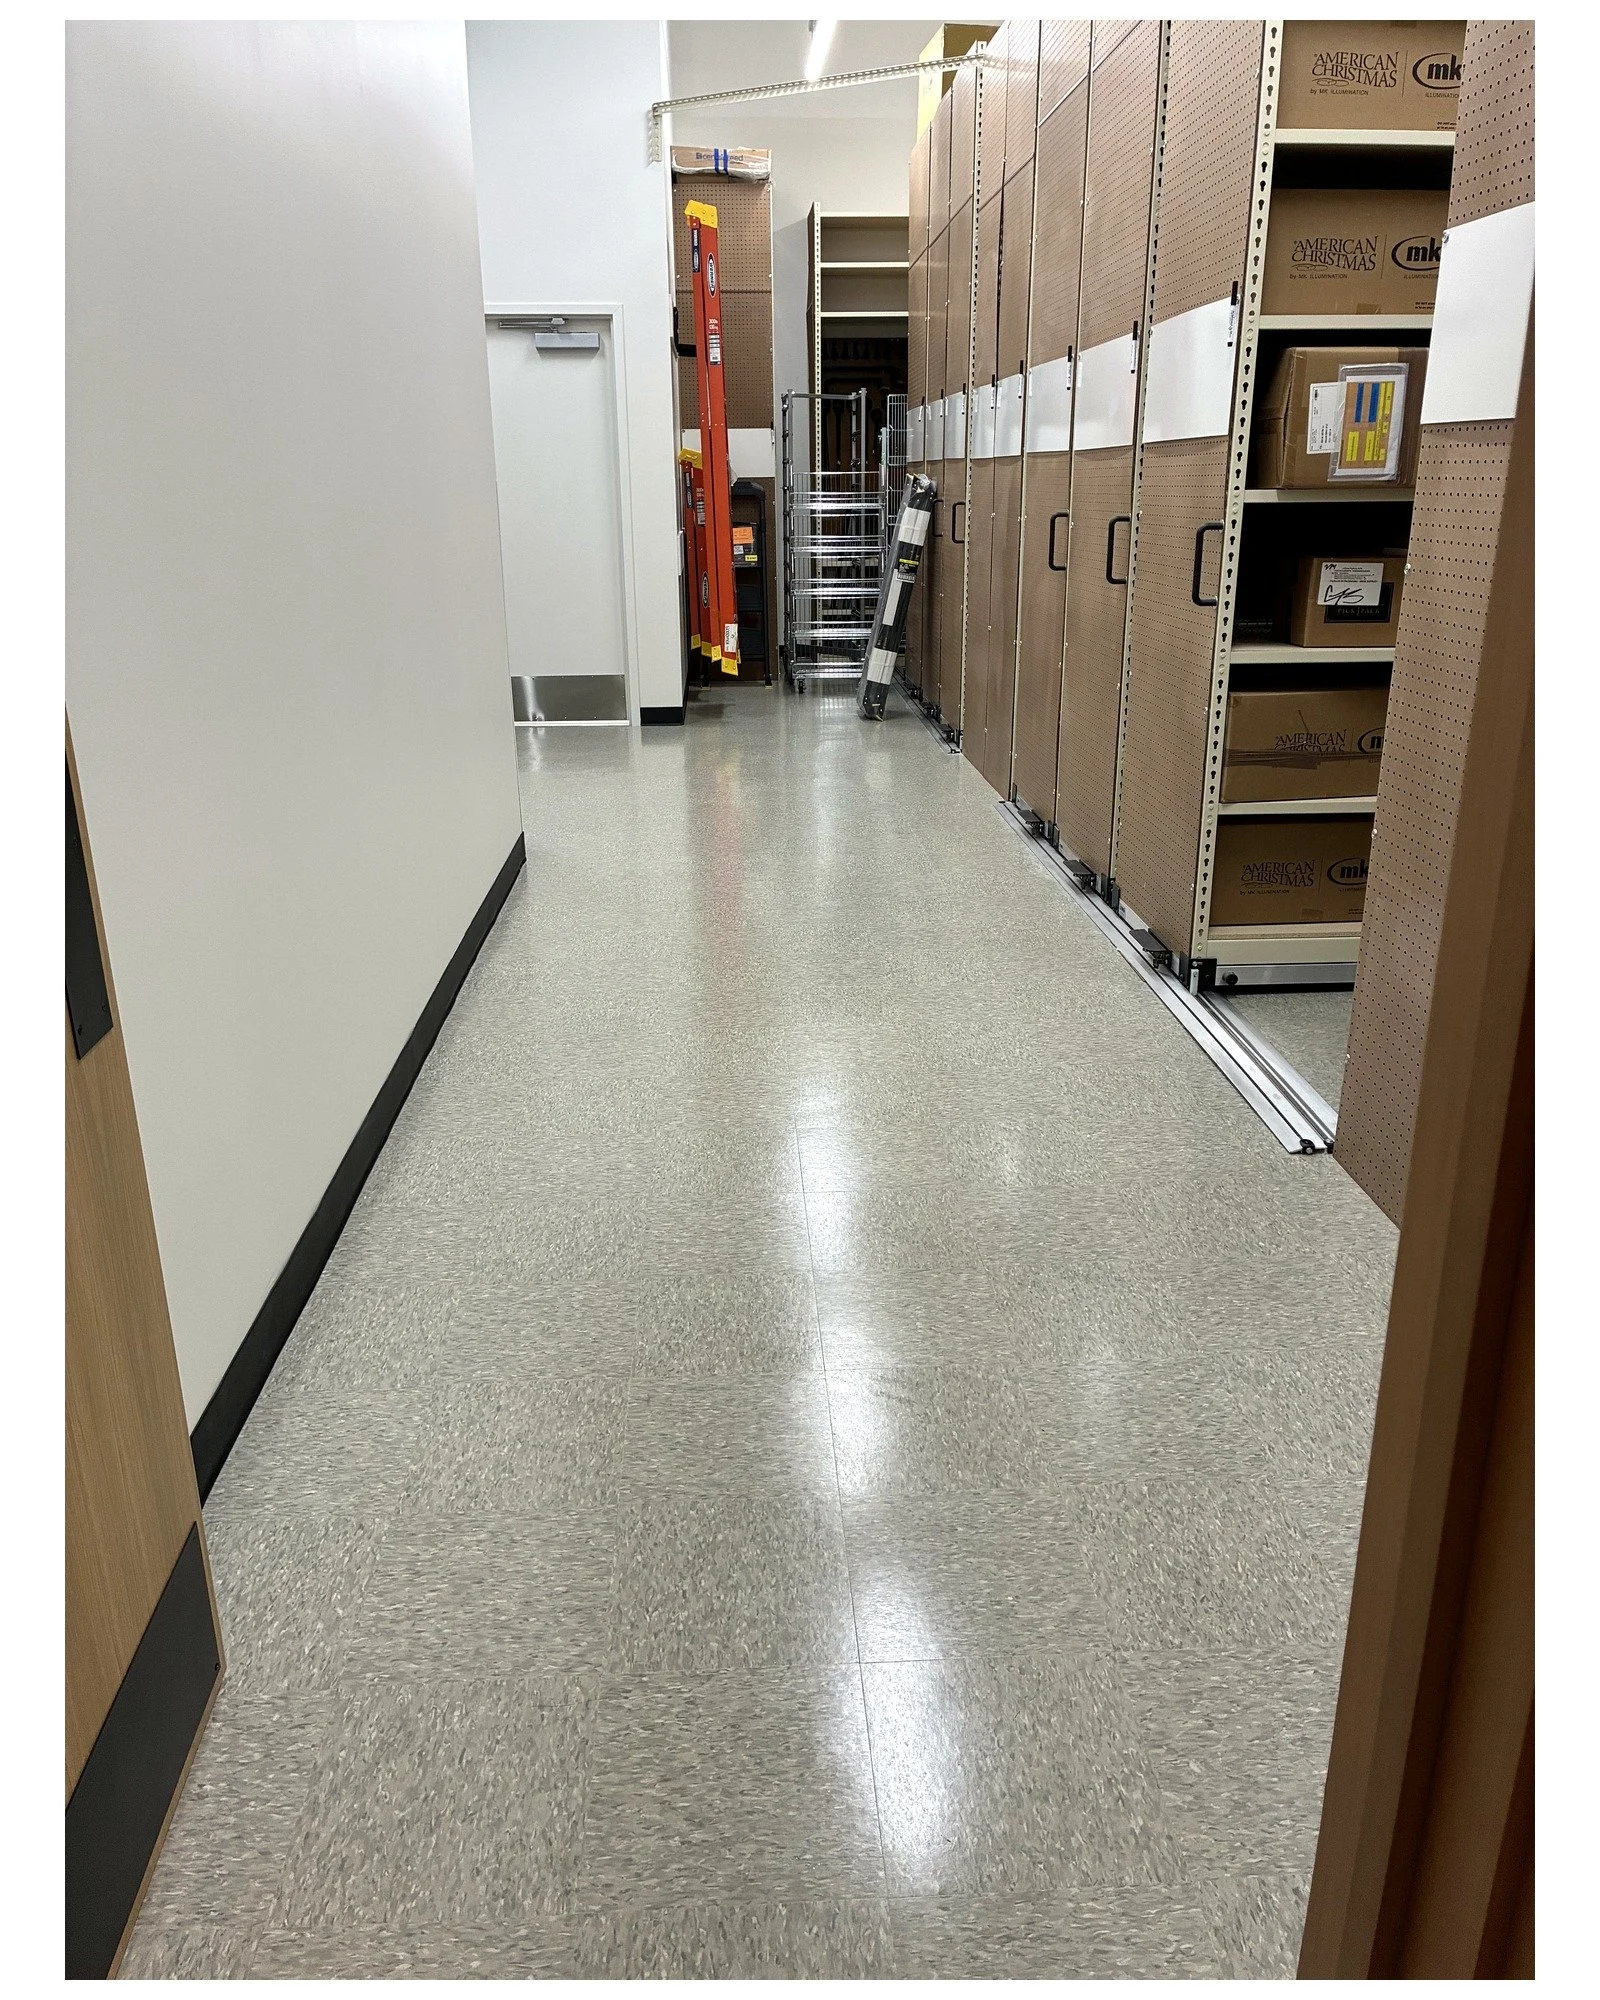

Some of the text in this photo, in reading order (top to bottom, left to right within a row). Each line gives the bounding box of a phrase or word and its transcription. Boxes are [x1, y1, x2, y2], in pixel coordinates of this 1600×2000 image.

[1314, 51, 1399, 71] AMERICAN
[1427, 54, 1461, 80] mk
[1312, 64, 1397, 88] CHRISTMAS
[1294, 236, 1378, 254] AMERICAN
[1406, 237, 1441, 262] mk
[1291, 249, 1376, 271] CHRISTMAS
[1276, 729, 1346, 746] AMERICAN
[1370, 735, 1384, 749] m
[1243, 860, 1315, 874] AMERICAN
[1340, 859, 1368, 878] mk
[1241, 872, 1314, 887] CHRISTMAS
